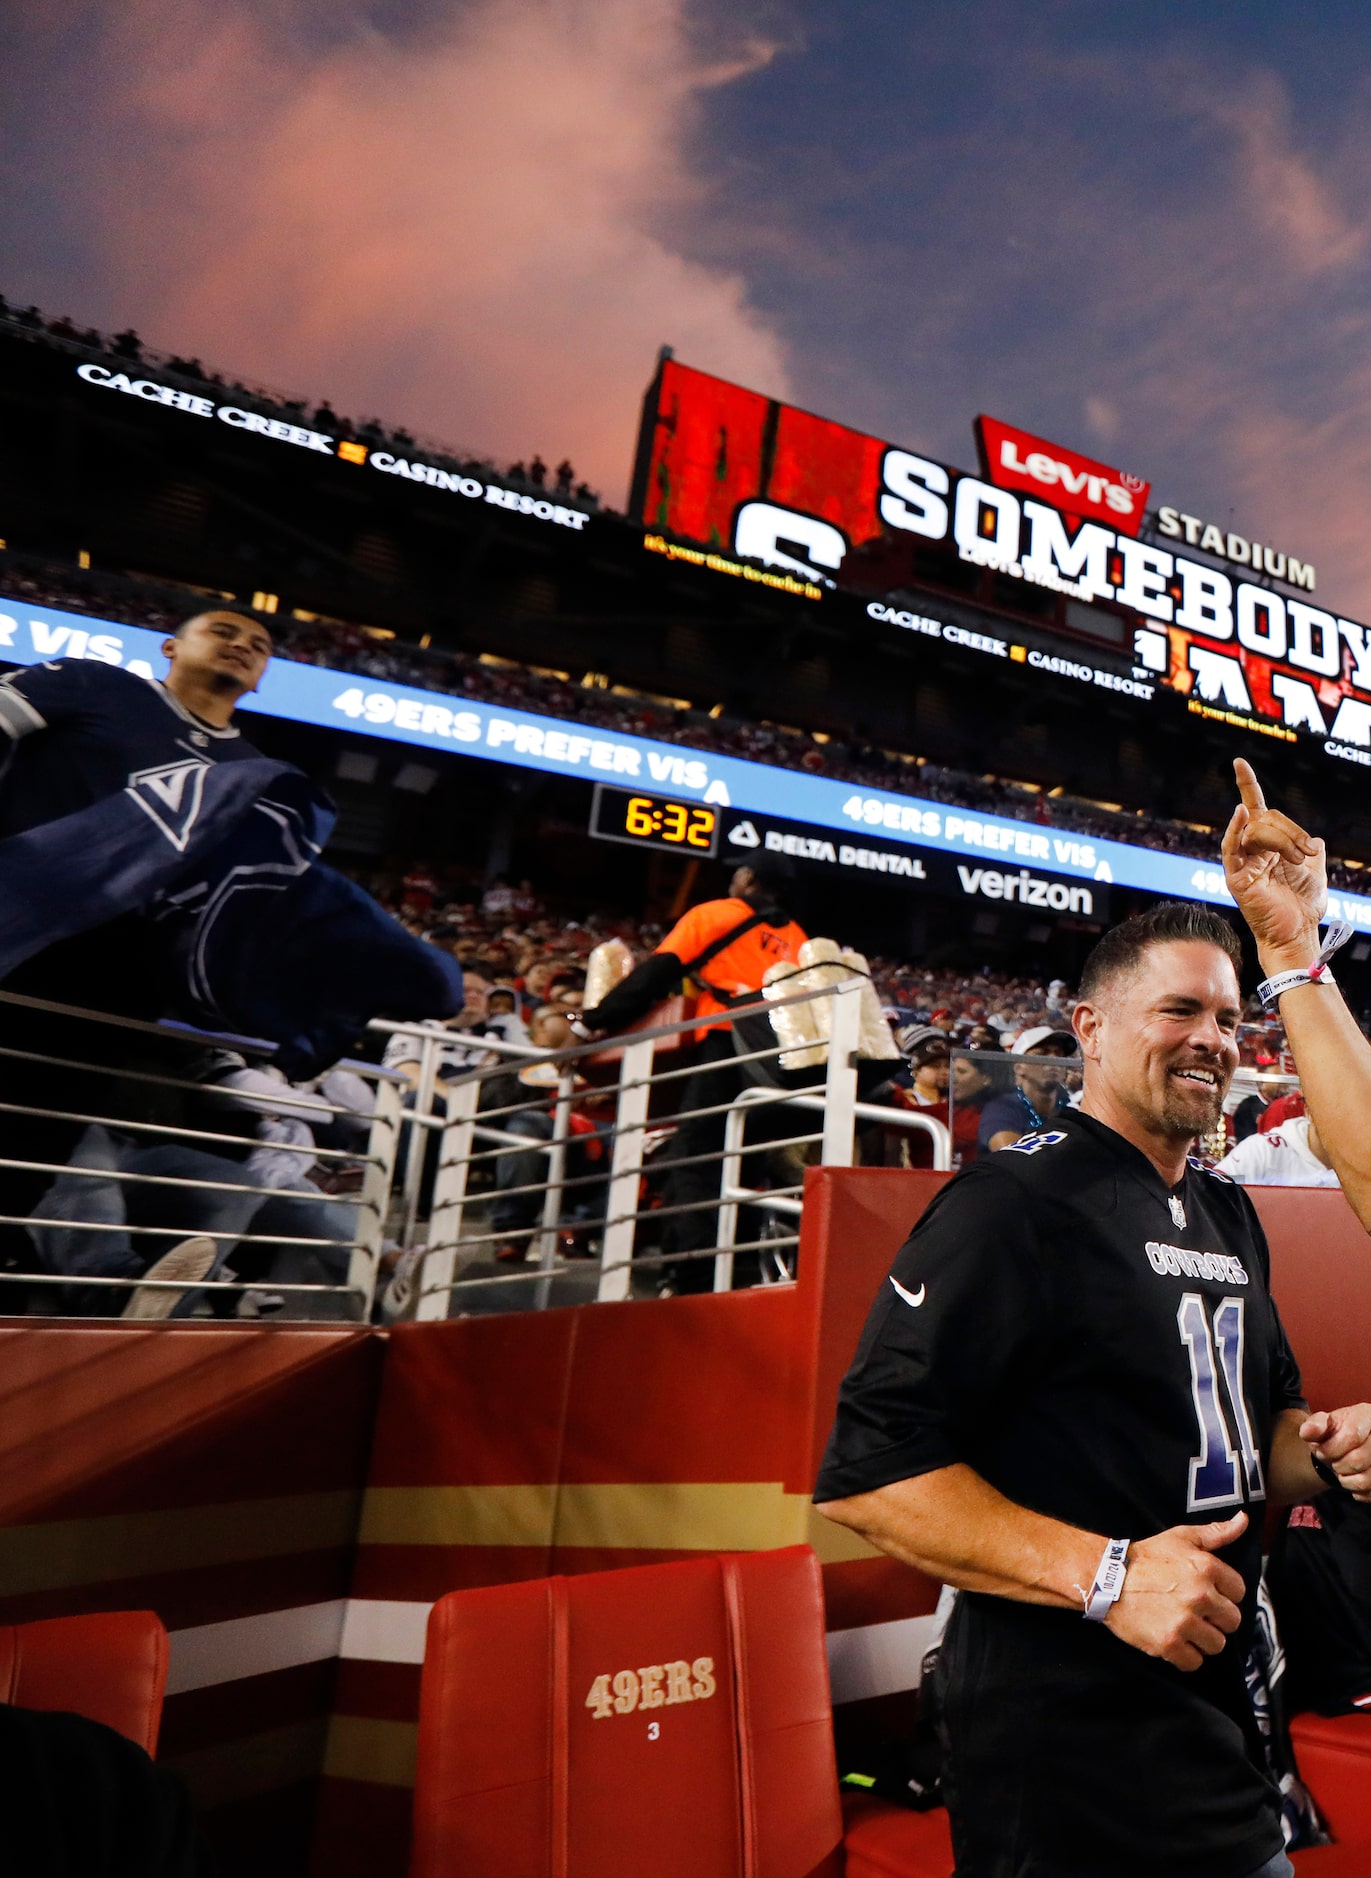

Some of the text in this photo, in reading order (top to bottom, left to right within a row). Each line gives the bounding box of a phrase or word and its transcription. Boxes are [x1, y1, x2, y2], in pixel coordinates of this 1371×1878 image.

[78, 363, 590, 530] CACHE CREEK CASINO RESORT
[1159, 505, 1316, 591] STADIUM
[866, 602, 1154, 700] CACHE CREEK CASINO RESORT
[333, 688, 481, 743] 49ERS
[486, 718, 642, 776] PREFER
[1324, 741, 1371, 767] CACHE
[625, 797, 715, 847] 6:32
[842, 795, 940, 838] 49ERS
[944, 816, 1050, 861] PREFER
[765, 831, 926, 879] DELTA DENTAL
[957, 865, 1093, 915] verizon
[1144, 1241, 1249, 1286] COWBOYS
[1176, 1292, 1266, 1513] 11
[585, 1657, 716, 1720] 49ERS
[647, 1721, 660, 1741] 3
